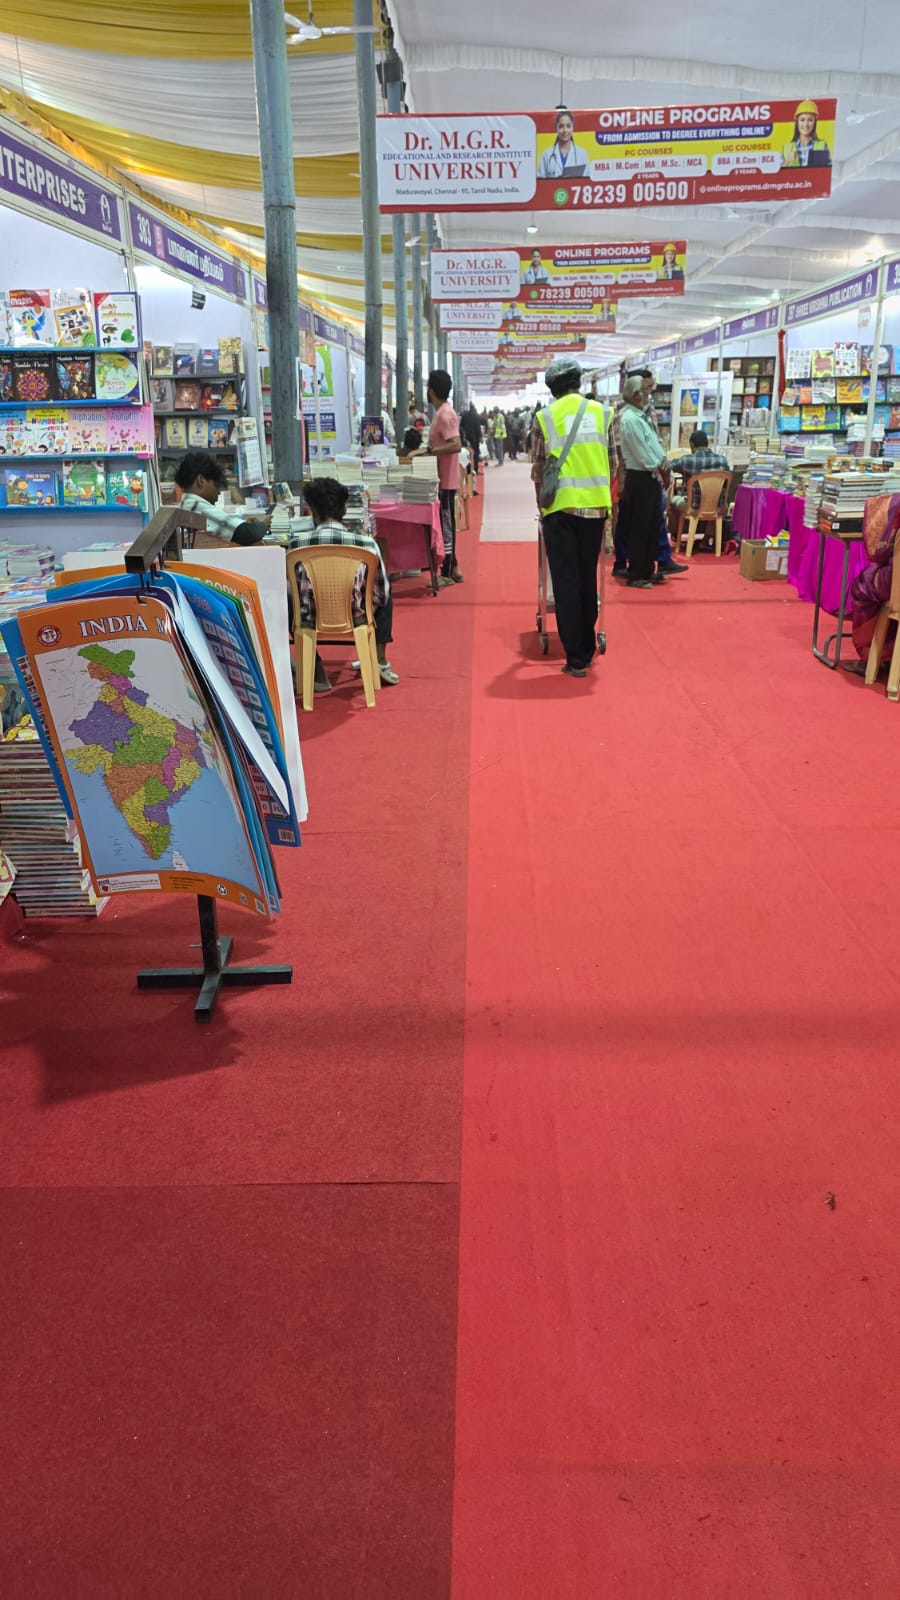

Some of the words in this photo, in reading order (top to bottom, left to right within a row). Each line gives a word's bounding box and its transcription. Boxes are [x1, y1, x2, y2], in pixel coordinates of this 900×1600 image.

[600, 110, 665, 127] ONLINE
[669, 105, 771, 124] PROGRAMS
[404, 131, 433, 151] Dr.
[440, 130, 511, 150] M.G.R.
[624, 131, 661, 141] ADMISSION
[662, 130, 671, 140] TO
[672, 129, 698, 139] DEGREE
[699, 127, 740, 138] EVERYTHING
[383, 152, 437, 161] EDUCATIONAL
[437, 152, 452, 160] AND
[453, 151, 492, 160] RESEARCH
[494, 150, 532, 158] INSTITUTE
[624, 149, 636, 157] PG
[637, 147, 673, 156] COURSES
[394, 161, 522, 181] UNIVERSITY
[594, 163, 610, 171] MBA
[616, 162, 640, 170] M.Com
[687, 158, 702, 166] MCA
[434, 187, 457, 195] Chennai
[471, 186, 485, 195] Tamil
[571, 184, 627, 205] 78239
[633, 181, 688, 202] 00500
[555, 248, 593, 258] ONLINE
[594, 246, 651, 257] PROGRAMS
[447, 259, 463, 270] Dr.
[467, 258, 507, 270] M.G.R.
[440, 275, 512, 287] UNIVERSITY
[540, 288, 571, 299] 78239
[574, 286, 606, 298] 00500
[829, 281, 863, 308] PUBLICATION
[446, 311, 496, 320] UNIVERSITY
[79, 615, 149, 637] INDIA
[155, 616, 168, 634] M
